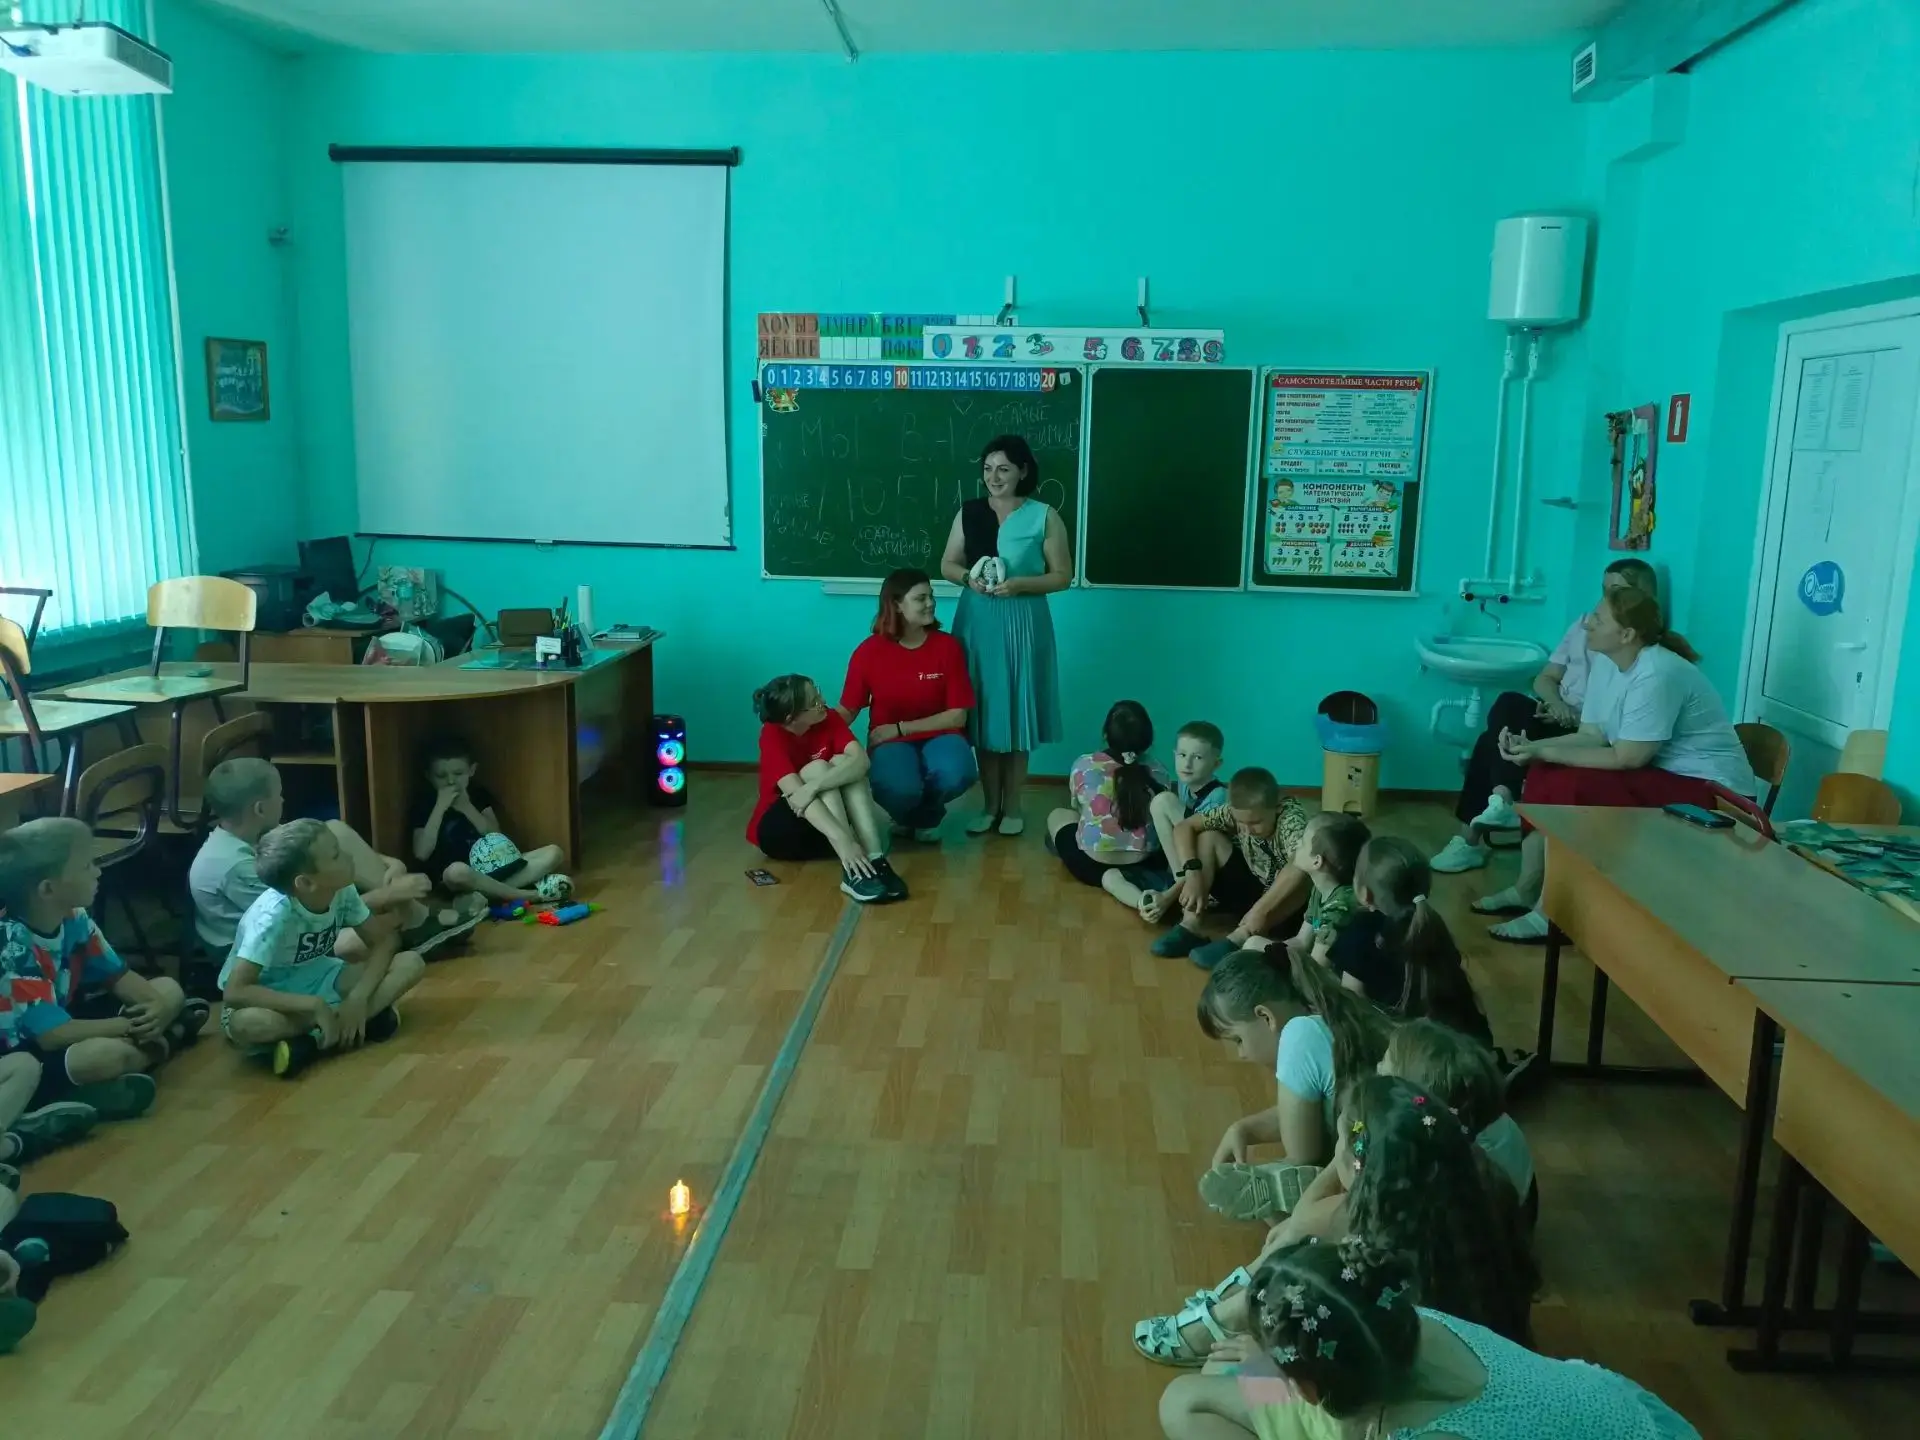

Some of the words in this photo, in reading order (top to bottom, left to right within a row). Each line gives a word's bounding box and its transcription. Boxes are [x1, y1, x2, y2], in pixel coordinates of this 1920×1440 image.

[932, 333, 952, 358] 0
[962, 336, 983, 359] 1
[992, 334, 1016, 358] 2
[1026, 333, 1054, 356] 3
[1083, 337, 1107, 360] 5
[1121, 337, 1144, 361] 6
[1151, 337, 1175, 361] 7
[1177, 337, 1200, 361] 8
[1203, 340, 1223, 363] 9
[767, 369, 775, 384] 0
[781, 369, 787, 385] 1
[793, 369, 801, 385] 2
[806, 369, 813, 385] 3
[819, 370, 828, 385] 4
[832, 370, 839, 385] 5
[844, 370, 852, 385] 6
[857, 370, 866, 386] 7
[871, 370, 879, 386] 8
[884, 370, 892, 386] 9
[895, 370, 908, 386] 10
[910, 370, 922, 386] 11
[925, 370, 938, 387] 12
[940, 371, 952, 387] 13
[954, 371, 968, 387] 14
[969, 371, 982, 387] 15
[983, 371, 997, 388] 16
[998, 371, 1011, 388] 17
[1013, 372, 1026, 388] 18
[1028, 372, 1041, 388] 19
[1041, 372, 1056, 388] 20
[1278, 377, 1363, 387] САМОСТОЯТЕЛЬНЫЕ
[1364, 379, 1393, 387] ЧАСТИ
[1394, 379, 1416, 387] РЕЧИ
[1287, 449, 1338, 457] СЛУЖЕБНЫЕ
[1303, 483, 1366, 491] КОМПОНЕНТЫ
[1316, 497, 1351, 505] ДЕЙСТВИЙ
